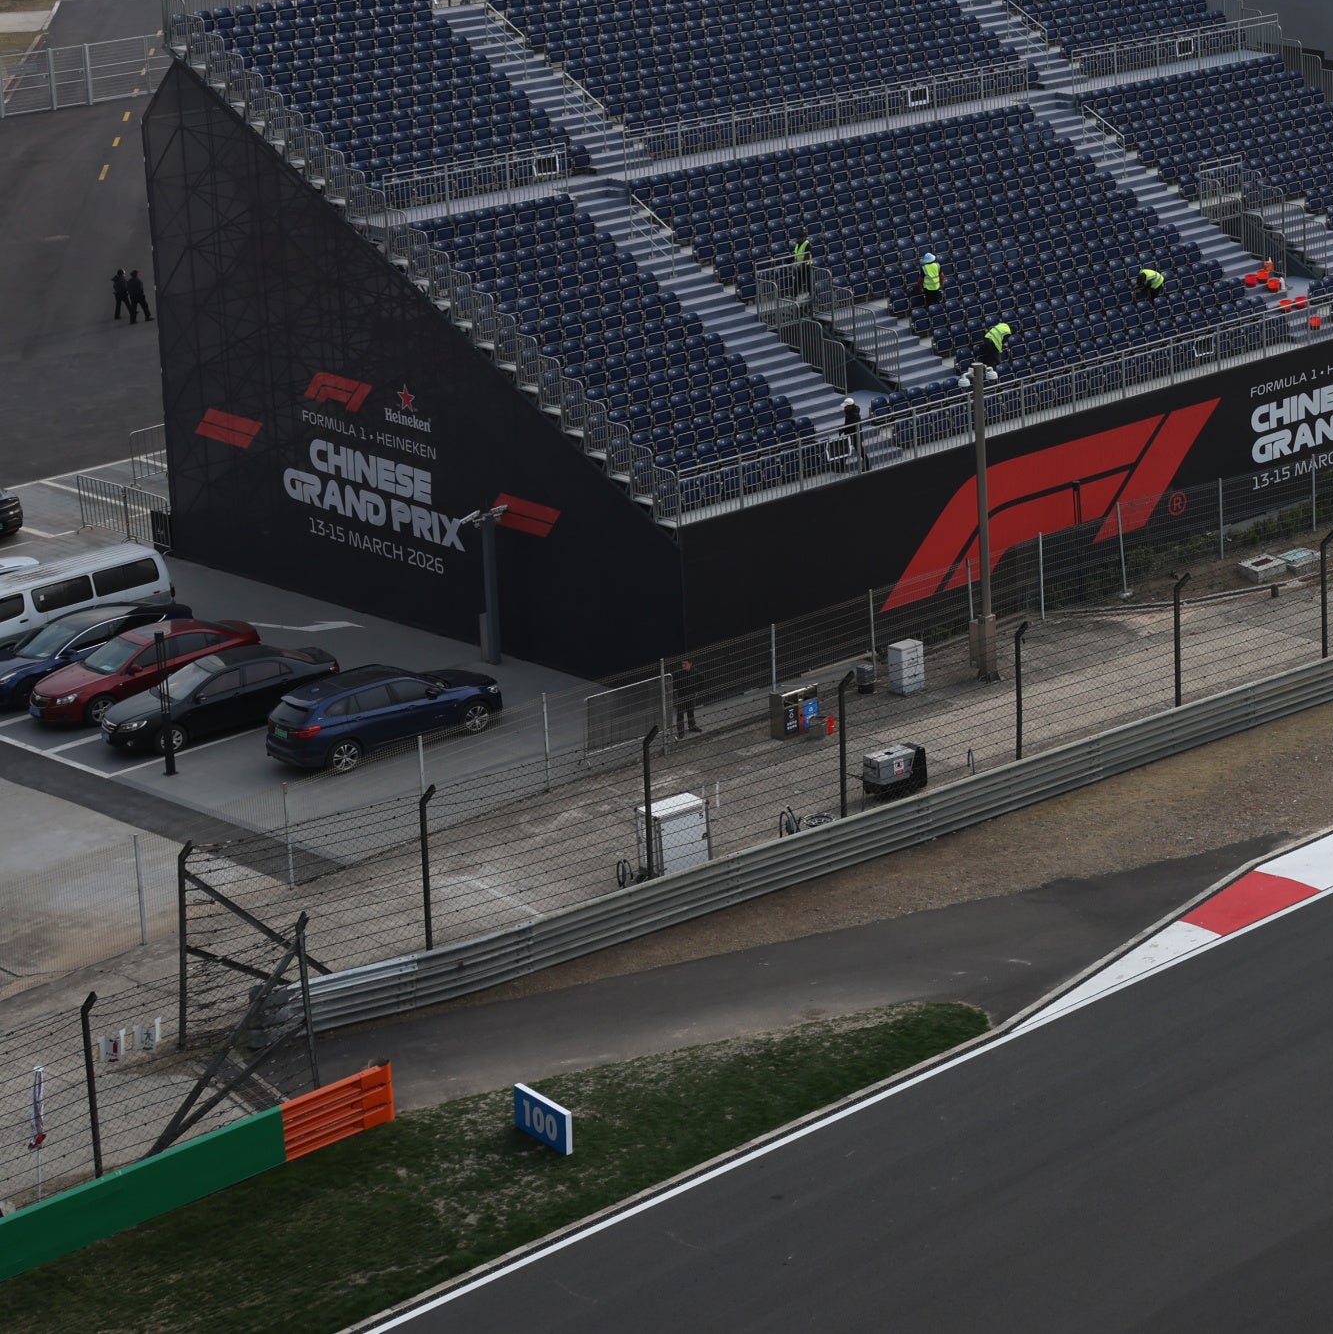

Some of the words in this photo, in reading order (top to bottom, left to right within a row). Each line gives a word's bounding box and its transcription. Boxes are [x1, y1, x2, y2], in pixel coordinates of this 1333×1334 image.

[1250, 372, 1307, 399] FORMULA
[1311, 369, 1317, 380] 1
[302, 409, 357, 438] FORMULA
[360, 426, 367, 441] 1
[376, 431, 436, 460] HEINEKEN
[384, 407, 432, 433] Heineken
[309, 438, 432, 506] CHINESE
[1252, 466, 1290, 490] 13-15
[283, 467, 386, 527] GRAND
[390, 498, 466, 553] PRIX
[308, 517, 345, 543] 13-15
[349, 530, 404, 562] MARCH
[407, 548, 444, 575] 2026
[523, 1099, 558, 1141] 100
